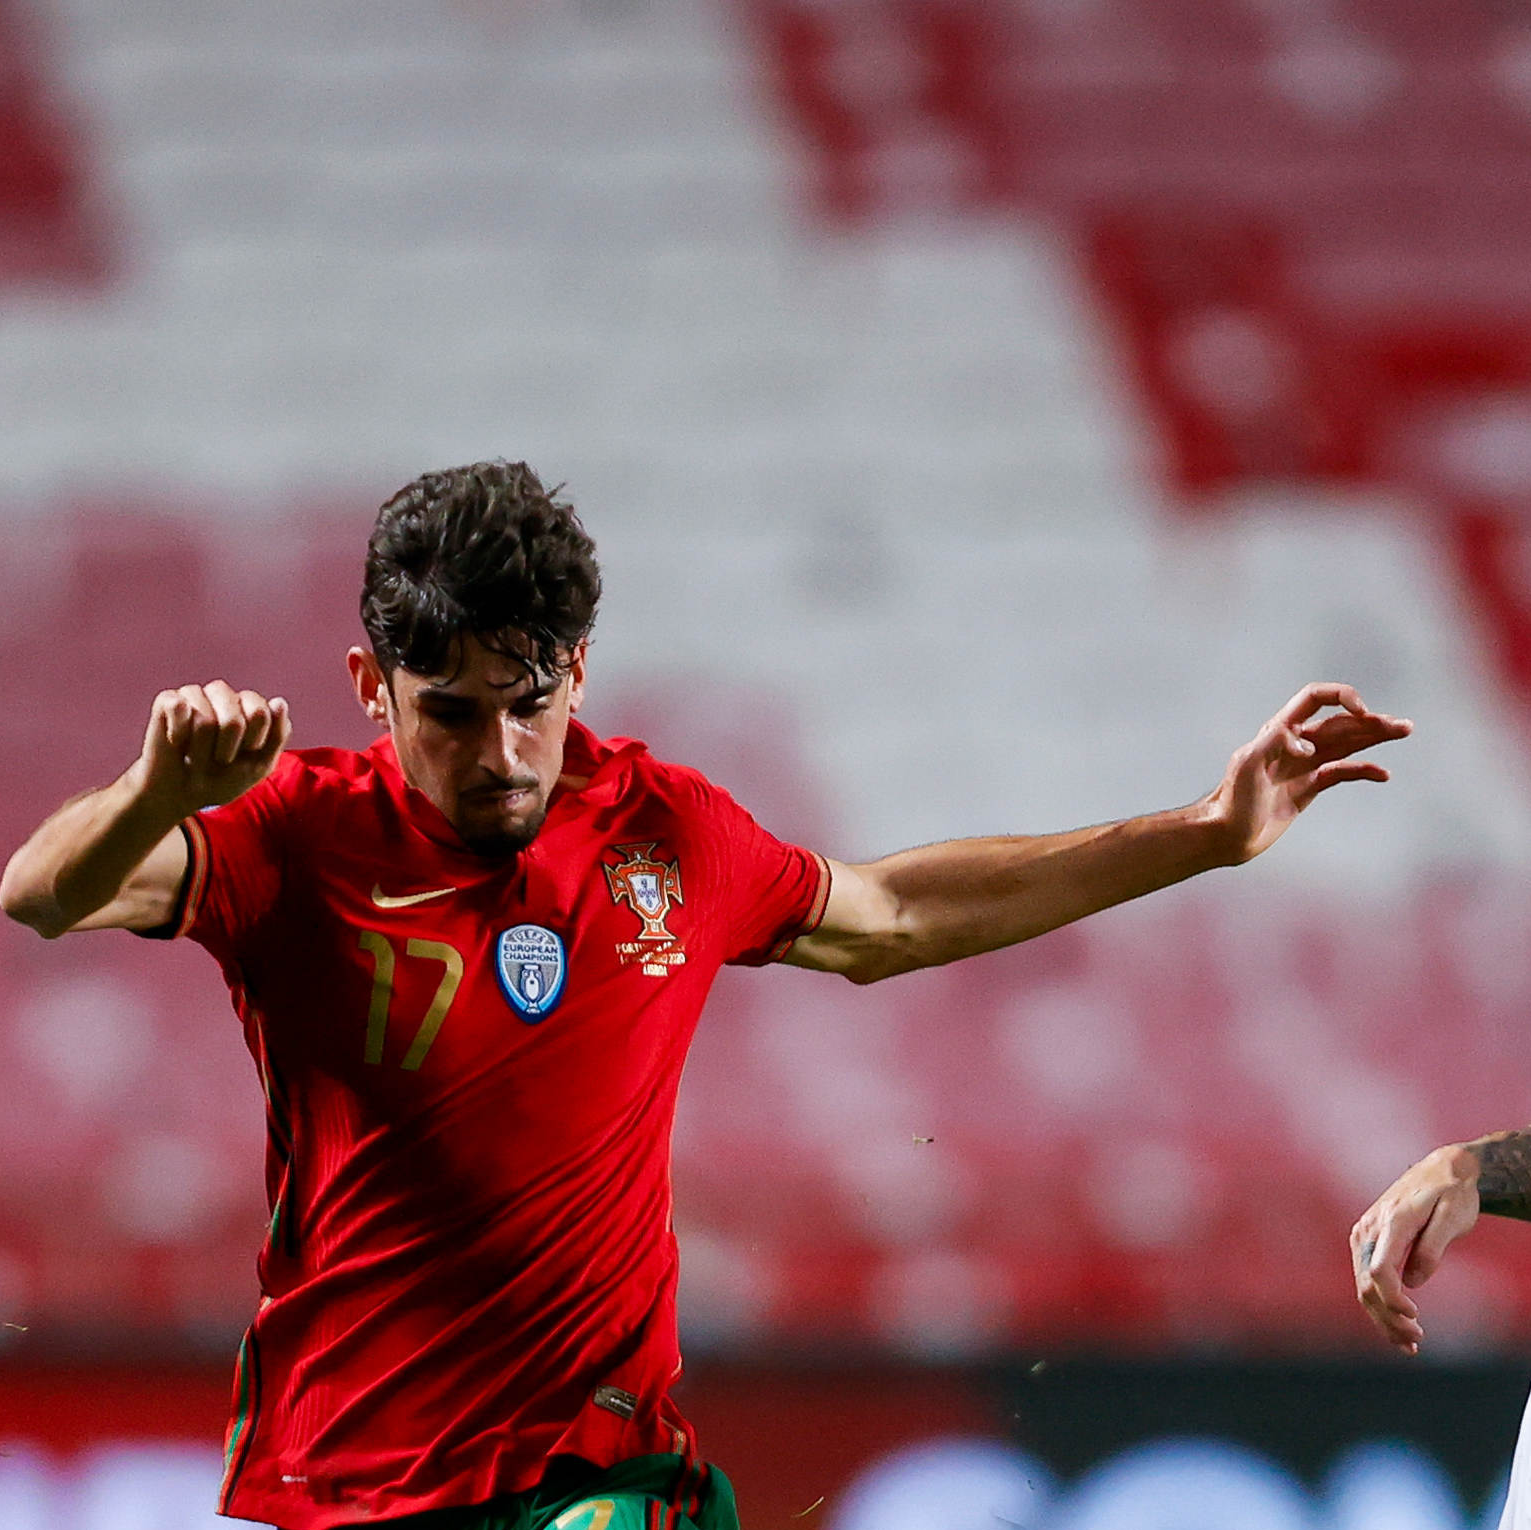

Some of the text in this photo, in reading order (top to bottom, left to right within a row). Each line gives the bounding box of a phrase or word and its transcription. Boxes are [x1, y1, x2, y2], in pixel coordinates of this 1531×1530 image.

[503, 943, 558, 954] EUROPEAN
[503, 952, 559, 962] CHAMPIONS
[358, 930, 464, 1071] 17
